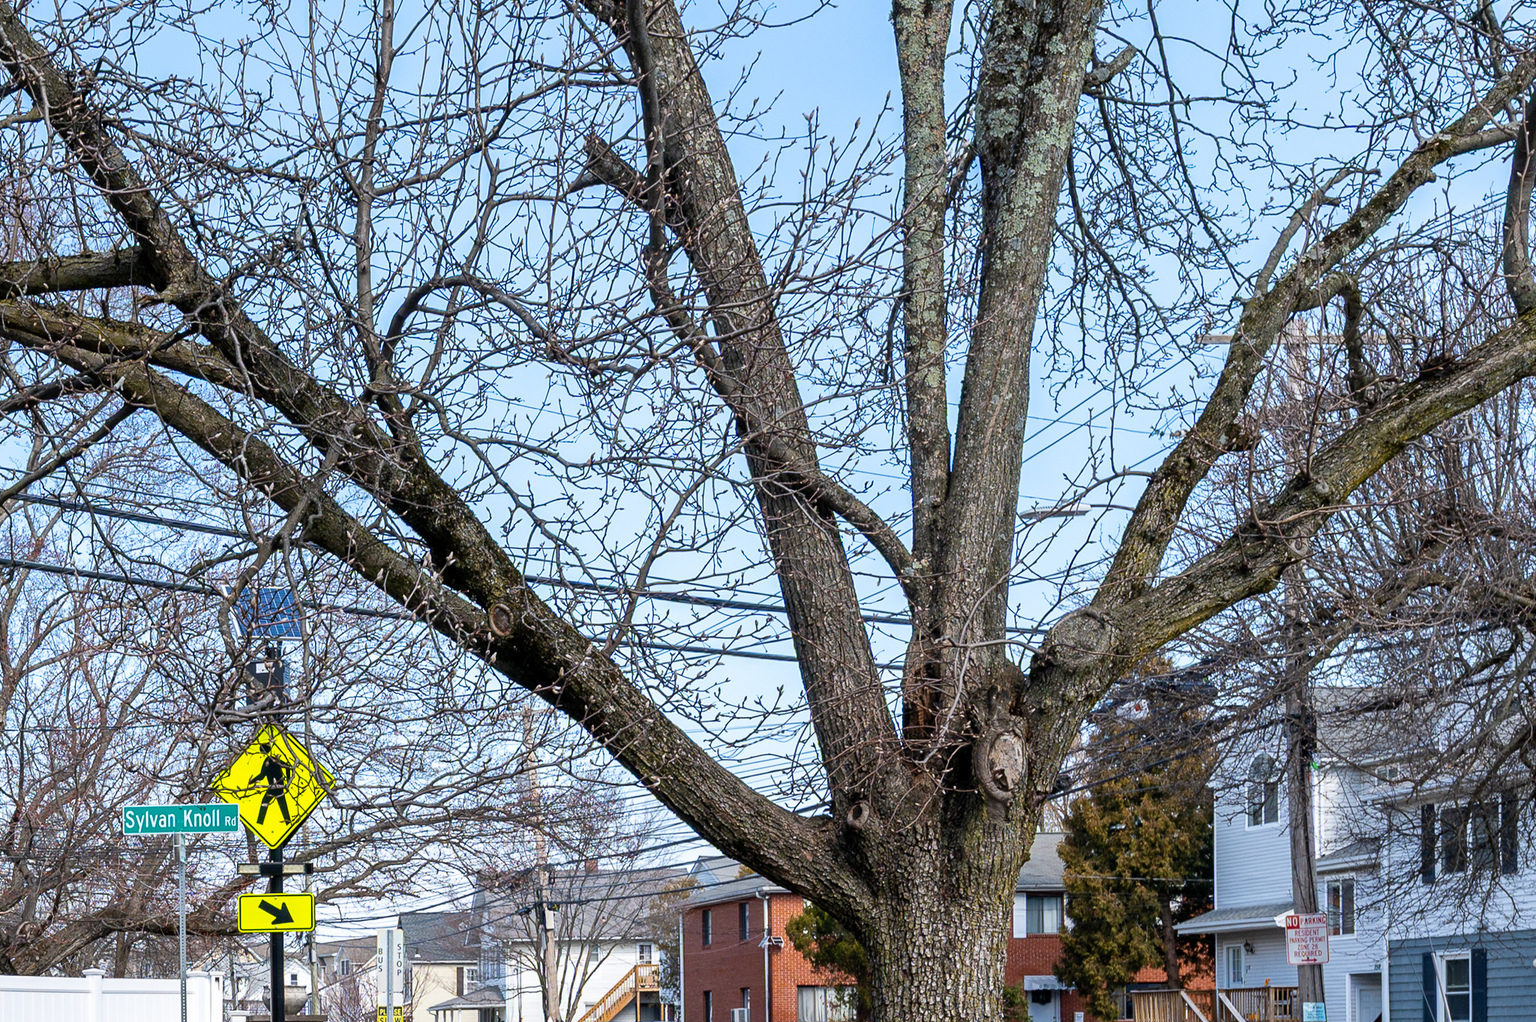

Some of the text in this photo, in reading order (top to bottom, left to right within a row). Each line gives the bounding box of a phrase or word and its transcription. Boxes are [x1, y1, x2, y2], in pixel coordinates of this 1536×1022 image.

[125, 809, 237, 833] Sylvan Knoll Rd
[1287, 917, 1326, 927] NO PARKING
[380, 1008, 401, 1016] PLSE
